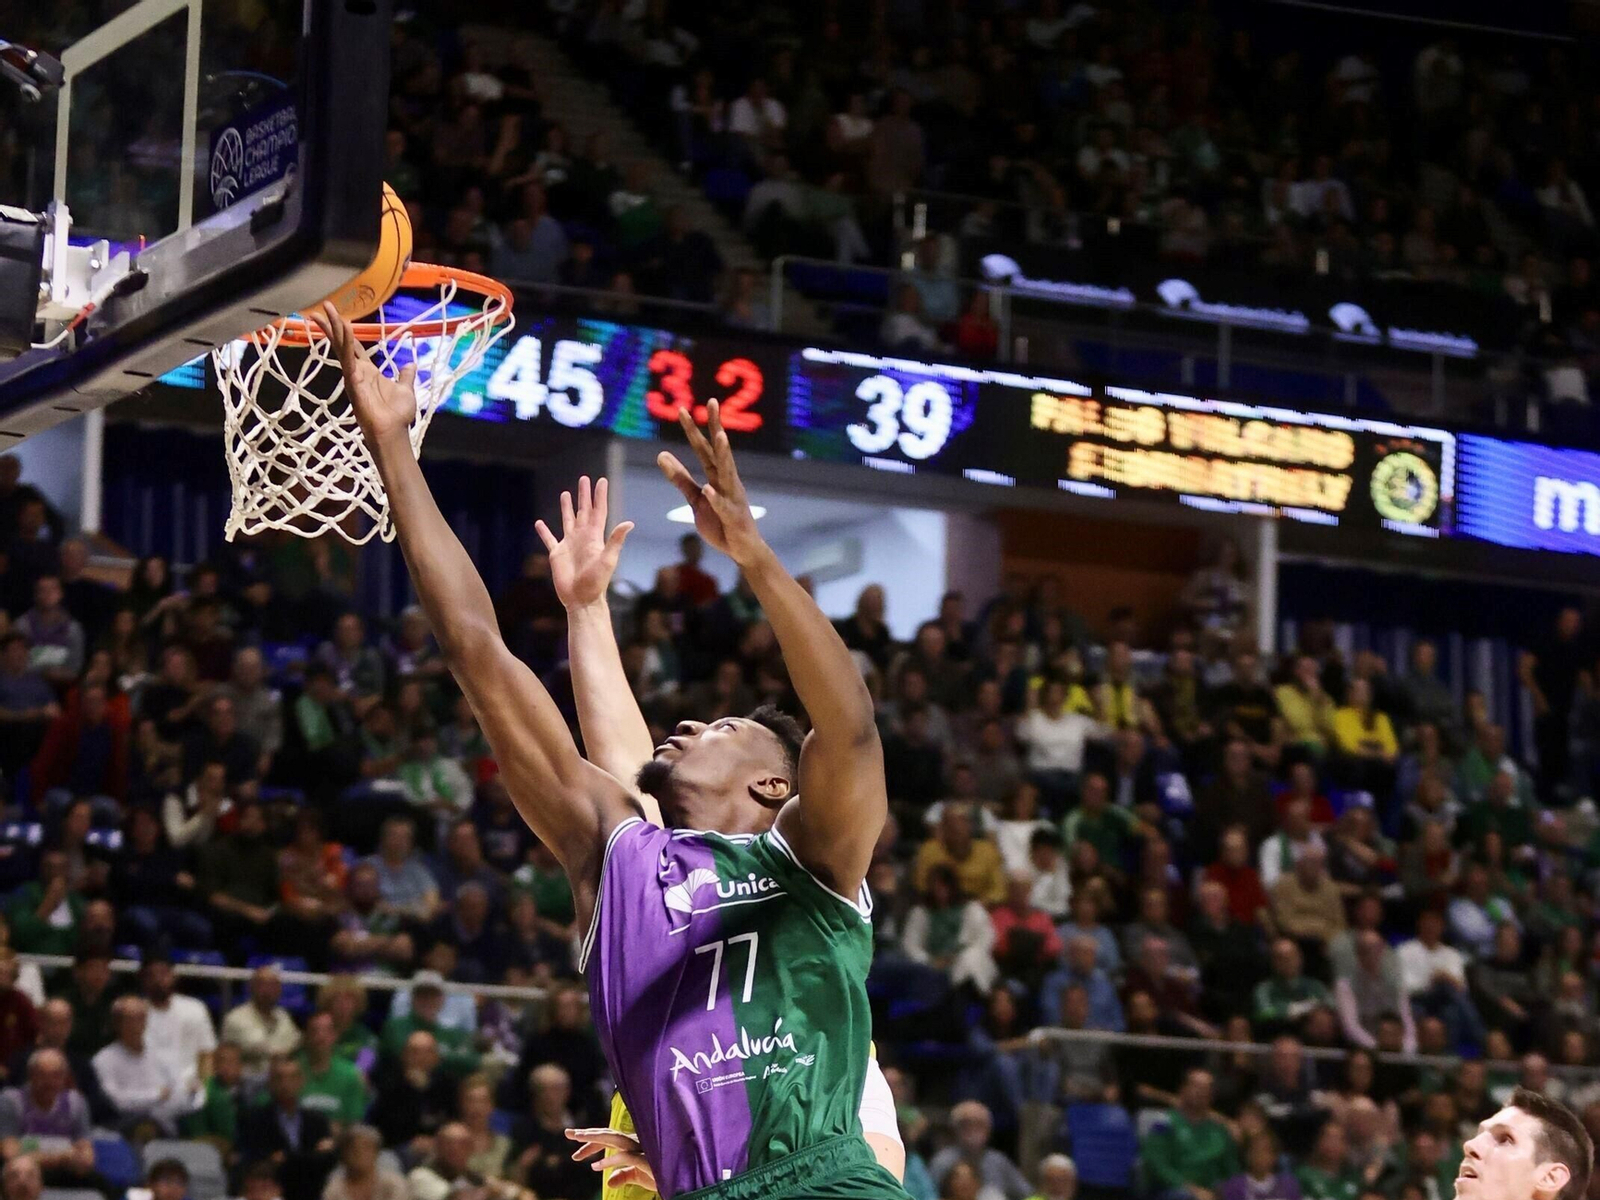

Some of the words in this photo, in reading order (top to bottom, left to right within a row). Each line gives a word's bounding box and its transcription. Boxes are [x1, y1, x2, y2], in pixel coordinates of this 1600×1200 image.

[243, 155, 280, 188] LEAGUE
[486, 335, 604, 428] 45
[646, 350, 764, 433] 3.2
[846, 374, 953, 460] 39
[694, 931, 759, 1011] 77
[670, 1017, 798, 1083] Andalucía
